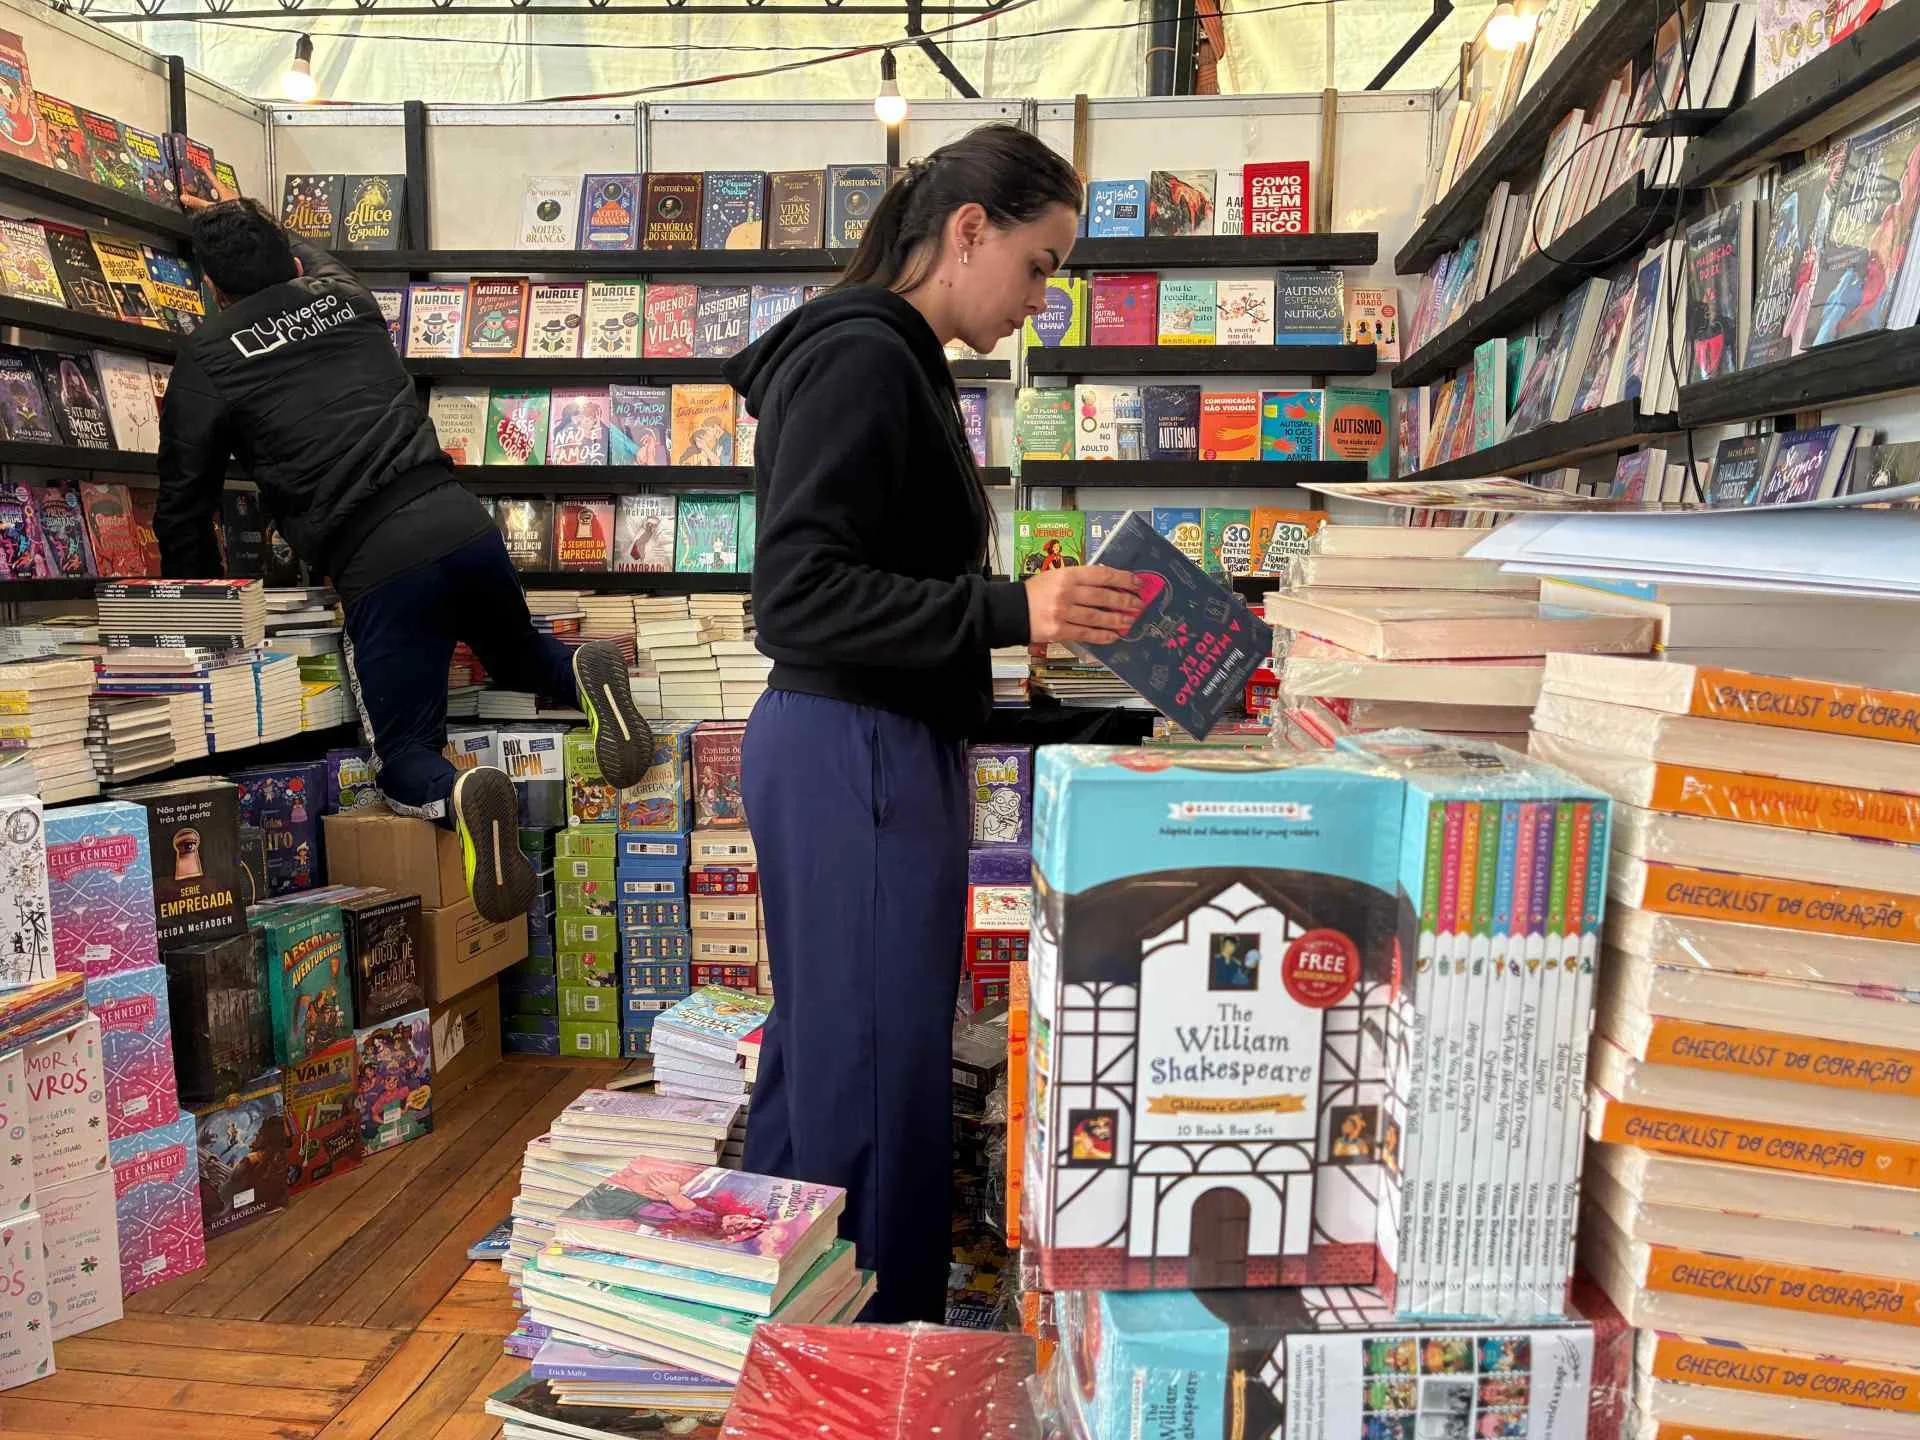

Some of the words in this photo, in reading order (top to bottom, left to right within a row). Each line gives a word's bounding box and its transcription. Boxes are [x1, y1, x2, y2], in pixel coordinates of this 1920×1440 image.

[1252, 175, 1301, 187] COMO
[1095, 189, 1138, 201] AUTISMO
[1252, 185, 1301, 196] FALAR
[780, 203, 810, 214] VIDAS
[1252, 195, 1301, 209] BEM
[344, 200, 392, 228] Alice
[595, 209, 627, 218] NOITES
[779, 214, 810, 226] SECAS
[1252, 211, 1301, 222] FICAR
[591, 217, 630, 226] BRANCAS
[650, 220, 693, 232] MEMÓRIAS
[1252, 220, 1301, 233] RICO
[531, 225, 562, 234] NOITES
[649, 231, 658, 241] DO
[659, 231, 694, 241] SUBSOLO
[526, 233, 567, 243] BRANCAS
[476, 285, 520, 295] MURDLE
[535, 289, 580, 300] MURDLE
[591, 286, 636, 297] MURDLE
[1164, 283, 1181, 293] Vou
[1182, 283, 1192, 292] te
[1284, 286, 1337, 296] AUTISMO
[414, 295, 461, 305] MURDLE
[1164, 292, 1198, 302] receitar
[1355, 292, 1382, 300] TORTO
[648, 294, 695, 315] APRENDIZ
[699, 293, 749, 318] ASSISTENTE
[755, 296, 797, 318] ALIADA
[253, 295, 339, 335] Universo
[664, 313, 674, 323] DO
[717, 312, 728, 323] DO
[1037, 312, 1064, 321] MENTE
[1094, 316, 1125, 324] SINTONIA
[1284, 308, 1337, 319] NUTRIÇÃO
[287, 302, 357, 342] Cultural
[1037, 322, 1065, 330] HUMANA
[649, 318, 689, 345] VILÃO
[705, 318, 740, 342] VILÃO
[1204, 397, 1257, 406] COMUNICAÇÃO
[1204, 404, 1221, 412] NÃO
[512, 408, 526, 421] EU
[616, 405, 631, 415] NO
[634, 403, 665, 413] FUNDO
[69, 416, 107, 437] MORTE
[634, 416, 665, 425] AMOR
[1280, 420, 1313, 428] AUTISMO
[1333, 418, 1382, 435] AUTISMO
[555, 426, 585, 445] NÃO
[1158, 427, 1197, 449] AUTISMO
[1295, 437, 1313, 445] TOS
[1300, 445, 1313, 453] DE
[1286, 453, 1313, 461] AMOR
[1177, 525, 1200, 542] 30
[1227, 526, 1250, 541] 30
[1279, 526, 1302, 542] 30
[567, 540, 594, 549] SEGREDO
[1271, 547, 1311, 555] ENTENDER
[559, 549, 607, 560] EMPREGADA
[1229, 618, 1241, 632] A
[1194, 631, 1215, 655] DO
[1179, 655, 1199, 675] EX
[503, 738, 521, 756] BOX
[504, 752, 544, 777] LUPIN
[638, 783, 665, 793] GREGA
[157, 806, 174, 815] Não
[176, 803, 196, 813] espie
[199, 801, 213, 811] por
[159, 816, 174, 824] trás
[176, 814, 187, 823] da
[190, 810, 211, 821] porta
[1158, 827, 1192, 838] Adapted
[1193, 827, 1208, 836] and
[1209, 826, 1250, 837] illustrated
[1251, 826, 1263, 837] for
[1264, 828, 1288, 839] young
[1290, 828, 1320, 837] readers
[51, 851, 77, 867] ELLE
[80, 843, 129, 862] KENNEDY
[160, 890, 233, 919] EMPREGADA
[1667, 882, 1773, 913] CHECKLIST
[1776, 897, 1804, 914] DO
[1804, 899, 1904, 930] CORAÇÃO
[291, 932, 332, 961] ESCOLA
[368, 942, 398, 968] JOGOS
[402, 940, 413, 960] DE
[291, 942, 343, 989] AVENTUREIROS
[1298, 951, 1346, 973] FREE
[100, 1004, 150, 1025] KENNEDY
[1217, 1003, 1253, 1022] The
[1523, 1003, 1534, 1013] A
[1175, 1025, 1291, 1055] William
[26, 1051, 66, 1075] MOR
[1671, 1036, 1780, 1067] CHECKLIST
[1784, 1051, 1810, 1070] DO
[1813, 1055, 1913, 1084] CORAÇÃO
[1149, 1055, 1313, 1087] Shakespeare
[1535, 1057, 1549, 1096] Hamlet
[27, 1068, 88, 1101] VROS
[1170, 1100, 1226, 1112] Children's
[1228, 1099, 1282, 1112] Collection
[1177, 1124, 1191, 1136] 10
[1195, 1124, 1225, 1136] Book
[1229, 1124, 1252, 1136] Box
[1255, 1124, 1275, 1136] Set
[1625, 1117, 1733, 1149] CHECKLIST
[1736, 1134, 1763, 1152] DO
[1766, 1138, 1866, 1168] CORAÇÃO
[210, 1216, 230, 1230] RICK
[231, 1202, 267, 1223] RIORDAN
[1671, 1264, 1776, 1296] CHECKLIST
[1780, 1280, 1806, 1297] DO
[1807, 1284, 1905, 1314] CORAÇÃO
[1675, 1354, 1778, 1384] CHECKLIST
[1783, 1370, 1809, 1387] DO
[1810, 1375, 1910, 1402] CORAÇÃO
[1146, 1403, 1158, 1424] The
